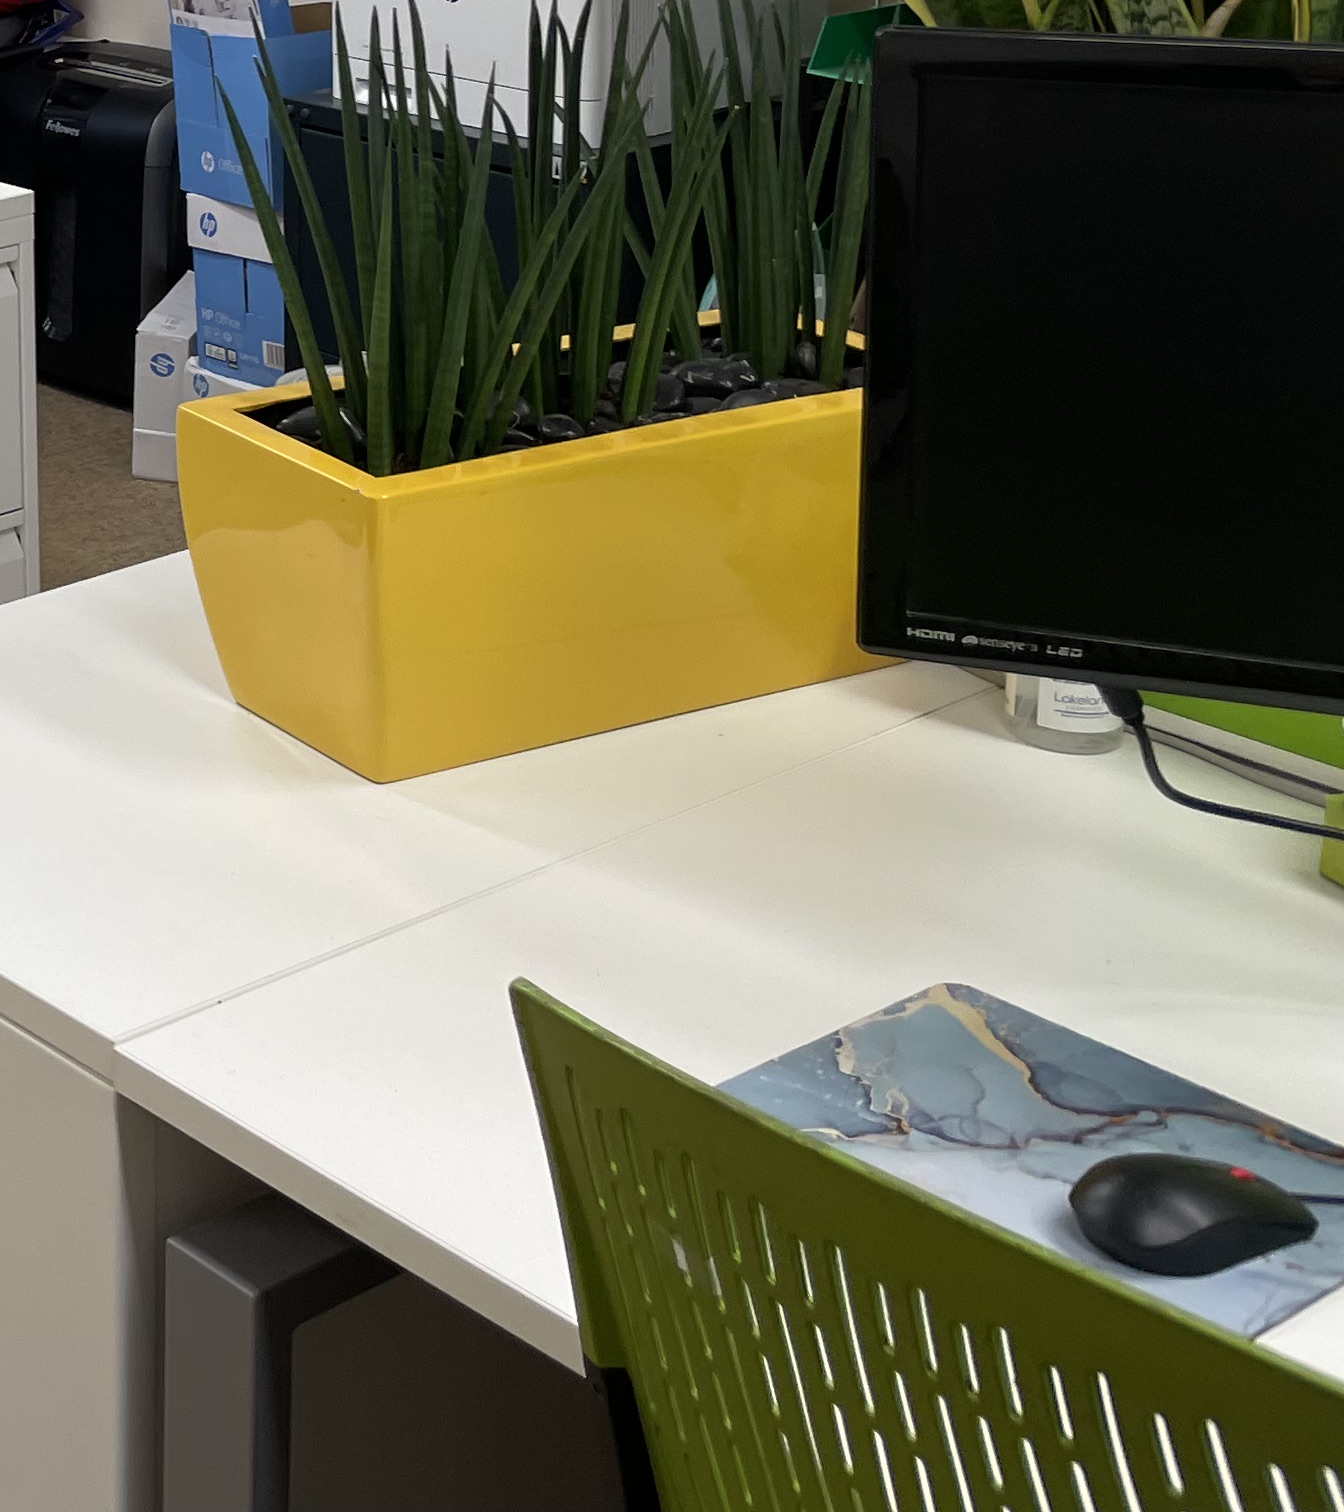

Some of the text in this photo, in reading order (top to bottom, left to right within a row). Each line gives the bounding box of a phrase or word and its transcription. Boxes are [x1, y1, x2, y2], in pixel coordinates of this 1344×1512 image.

[200, 212, 217, 238] hp
[201, 307, 214, 321] HP
[906, 627, 956, 642] HDMI
[1045, 644, 1083, 658] LED
